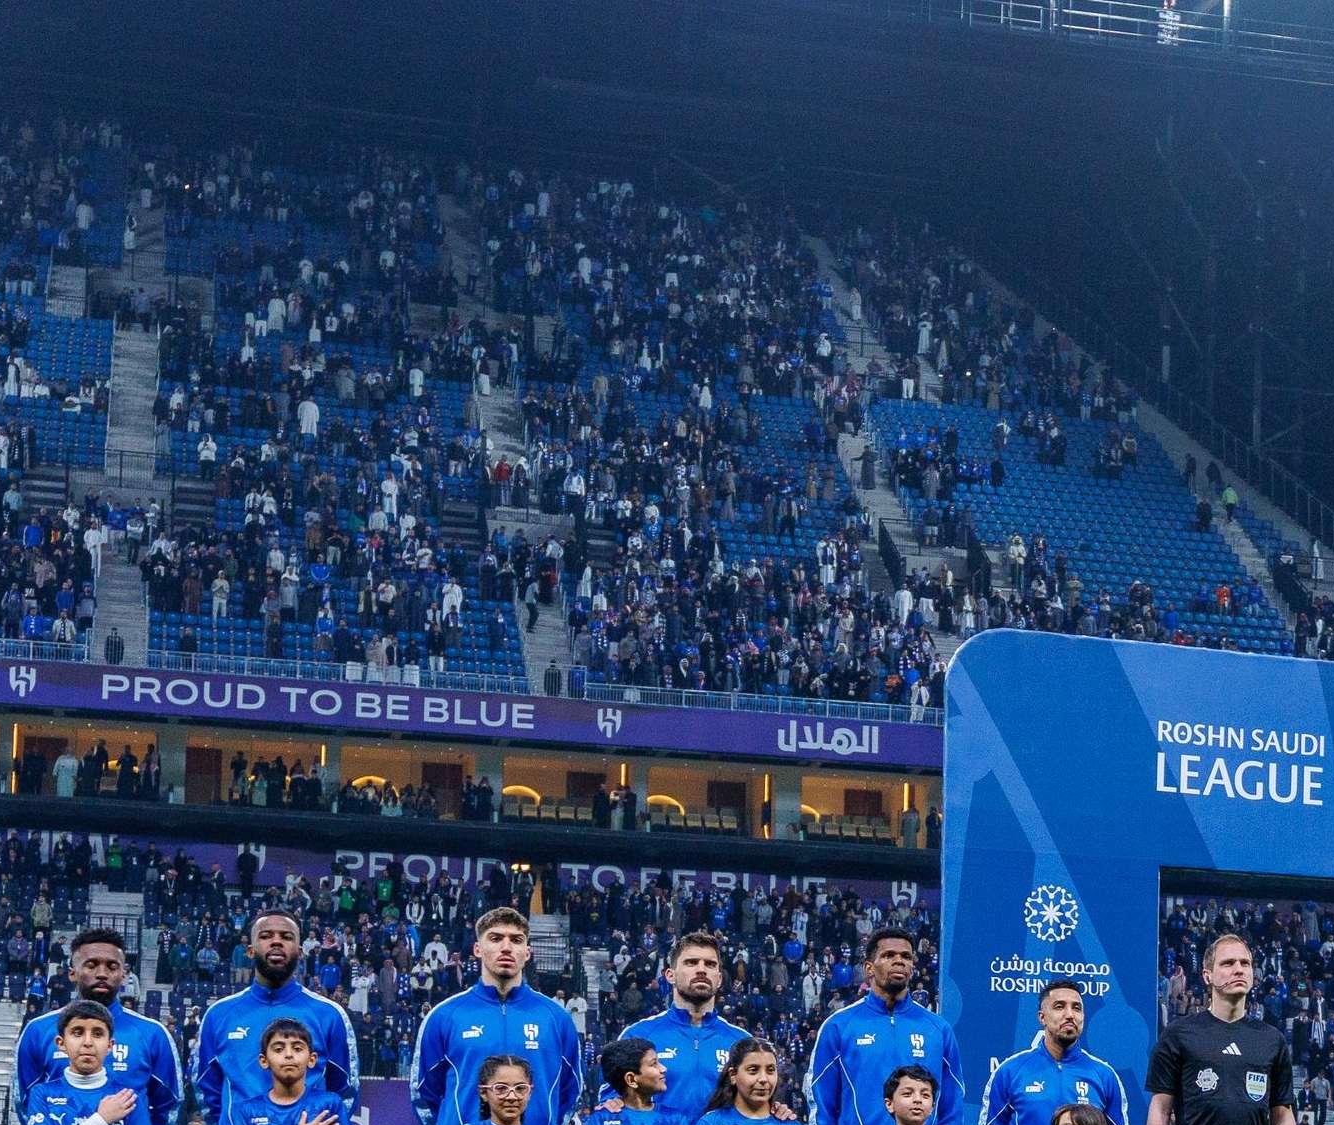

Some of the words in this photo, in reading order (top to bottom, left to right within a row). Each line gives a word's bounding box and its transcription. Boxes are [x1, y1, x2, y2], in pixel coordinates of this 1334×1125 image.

[101, 673, 266, 711] PROUD
[279, 685, 343, 717] TO
[355, 692, 410, 722] BE
[423, 696, 535, 730] BLUE
[777, 719, 880, 756] الهلال
[1156, 719, 1245, 750] ROSHN
[1250, 728, 1326, 758] SAUDI
[1155, 752, 1324, 807] LEAGUE
[990, 952, 1042, 976] روشن
[1043, 957, 1111, 978] مجموعة
[990, 976, 1049, 995] ROSHN
[1079, 980, 1110, 997] OUP
[1248, 1073, 1266, 1084] FIFA
